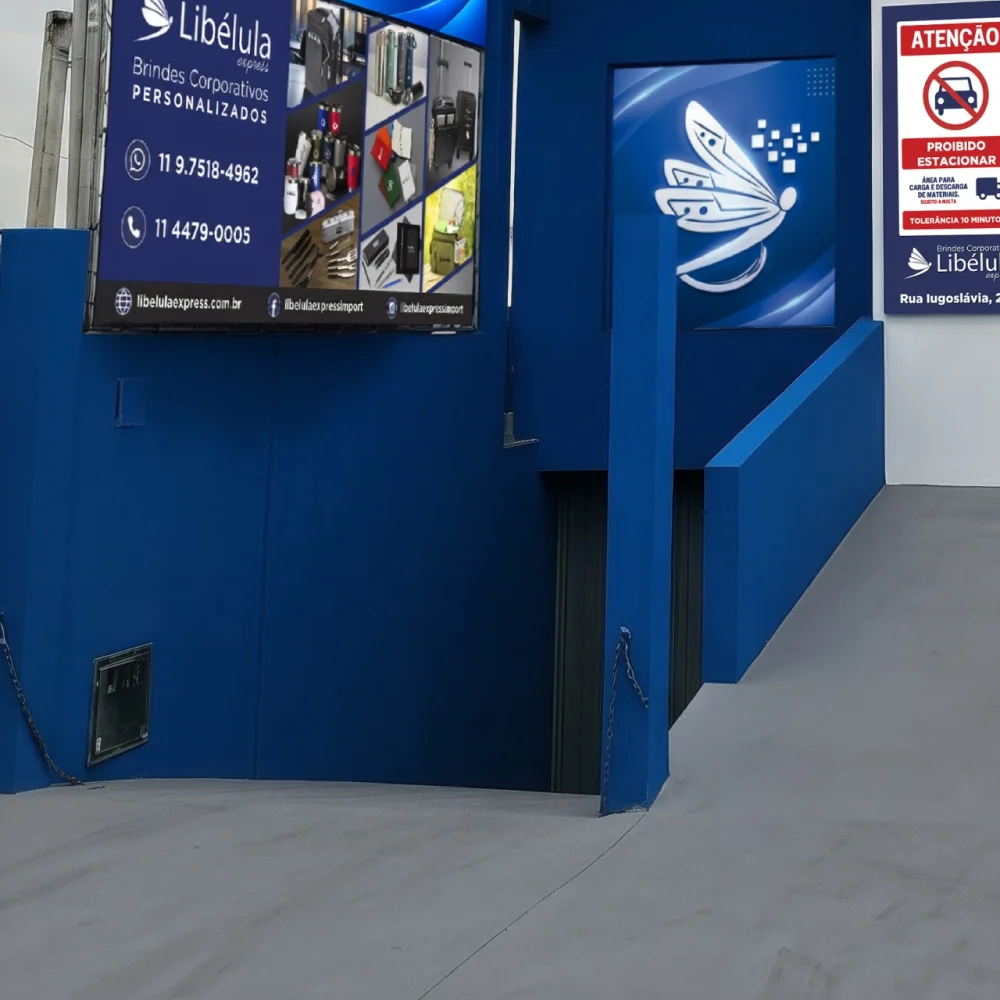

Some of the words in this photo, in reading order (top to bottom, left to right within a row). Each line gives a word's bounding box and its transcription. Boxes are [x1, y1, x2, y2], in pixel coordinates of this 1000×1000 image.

[179, 1, 272, 60] Libélula
[911, 25, 1000, 52] ATENÇÃO
[237, 57, 270, 74] express
[132, 56, 185, 85] Brindes
[189, 69, 269, 102] Corporativos
[132, 84, 268, 125] PERSONALIZADOS
[927, 140, 986, 153] PROIBIDO
[158, 152, 170, 173] 11
[174, 154, 260, 185] 9.7518-4962
[917, 155, 997, 168] ESTACIONAR
[922, 176, 937, 184] ÁREA
[910, 216, 959, 225] TOLERÂNCIA
[155, 218, 167, 240] 11
[170, 220, 251, 245] 4479-0005
[937, 244, 965, 252] Brindes
[137, 294, 242, 311] libelulaexpress.com.br
[900, 293, 923, 304] Rua
[926, 292, 992, 306] Iugoslávia,
